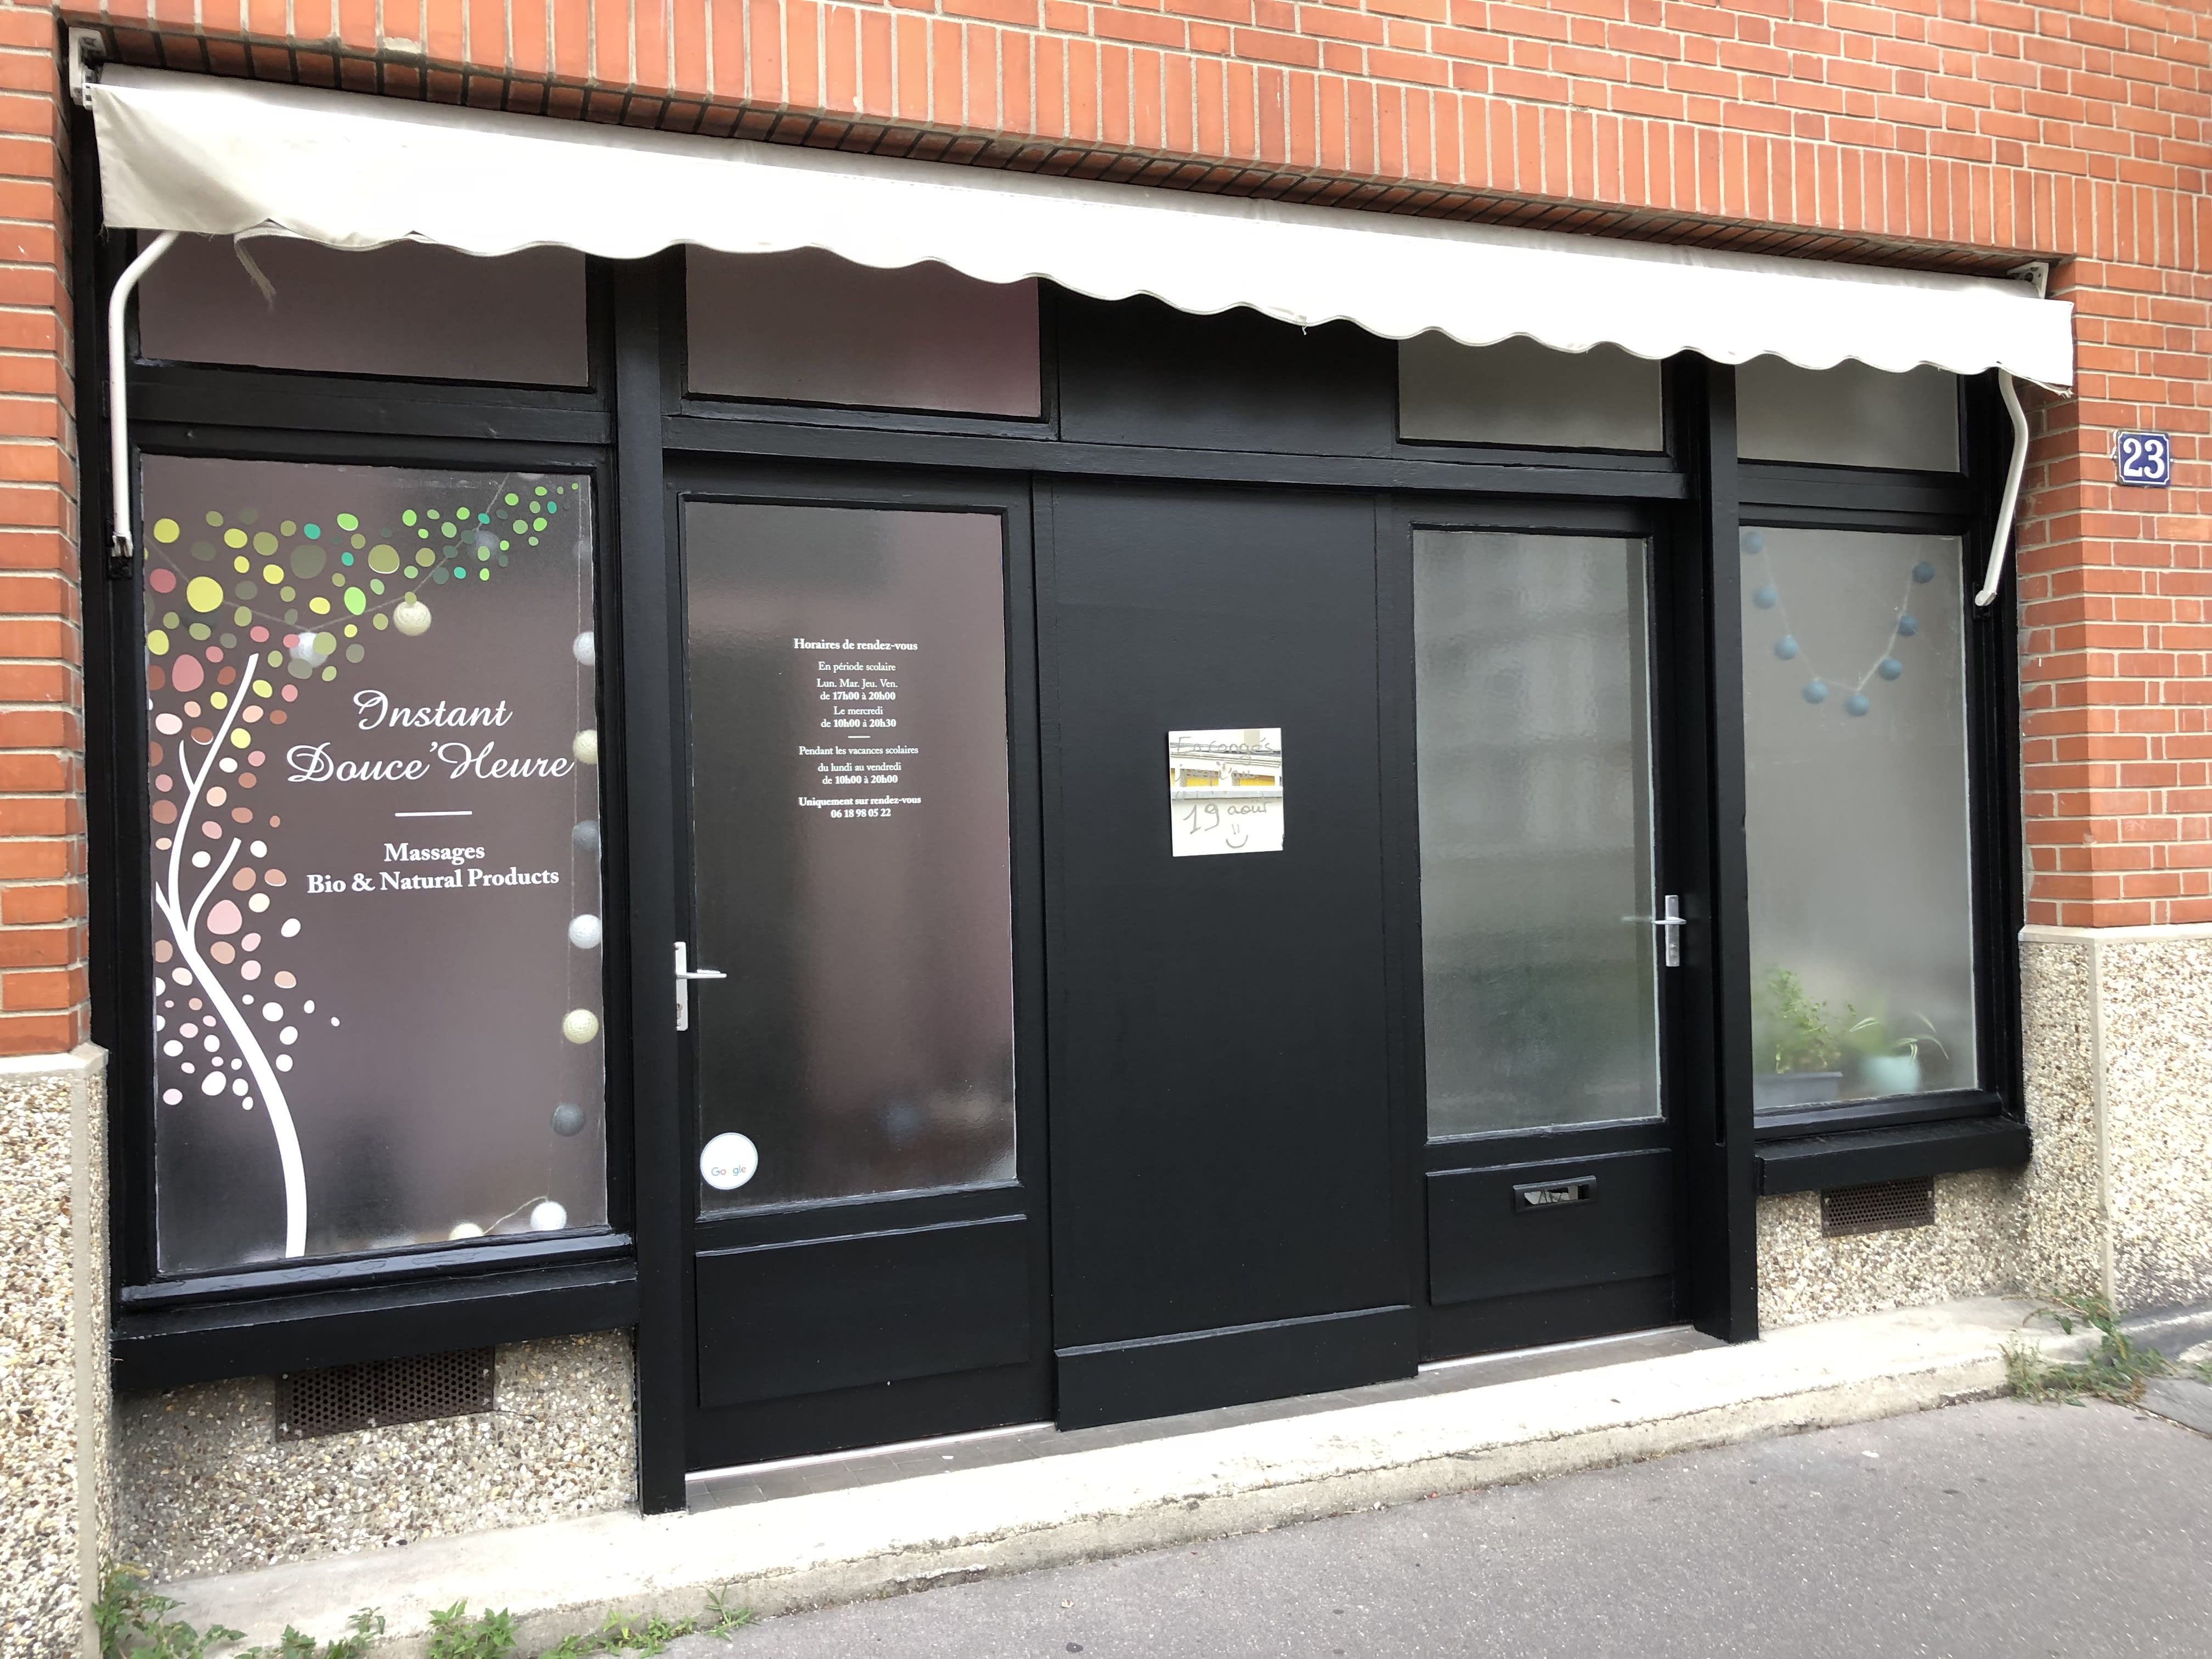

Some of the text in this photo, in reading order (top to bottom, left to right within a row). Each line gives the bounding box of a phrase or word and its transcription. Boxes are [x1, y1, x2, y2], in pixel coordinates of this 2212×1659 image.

[2123, 438, 2165, 479] 23
[793, 638, 918, 651] Horaires de rendez-vous
[818, 661, 896, 673] En période scolaire
[816, 678, 898, 690] Lun. Mar. Jeu. Ven.
[820, 691, 896, 701] de 17h00 à 20h00
[353, 690, 512, 730] Instant
[833, 706, 884, 715] Le mercredi
[821, 718, 896, 727] de 10h00 à 20h30
[798, 746, 834, 755] Pendant
[835, 746, 847, 755] les
[885, 745, 919, 754] scolaires
[1176, 736, 1202, 754] En
[817, 763, 829, 772] du
[831, 762, 853, 772] lundi
[866, 761, 902, 771] vendredi
[822, 774, 898, 785] de 10h00 à 20h00
[798, 797, 854, 809] Uniquement
[870, 795, 922, 805] rendez-vous
[831, 808, 891, 818] 06 18 98 05 22
[1182, 803, 1220, 834] 19
[384, 843, 485, 865] Massages
[307, 867, 559, 893] Bio & Natural Products
[711, 1164, 747, 1176] Gogle
